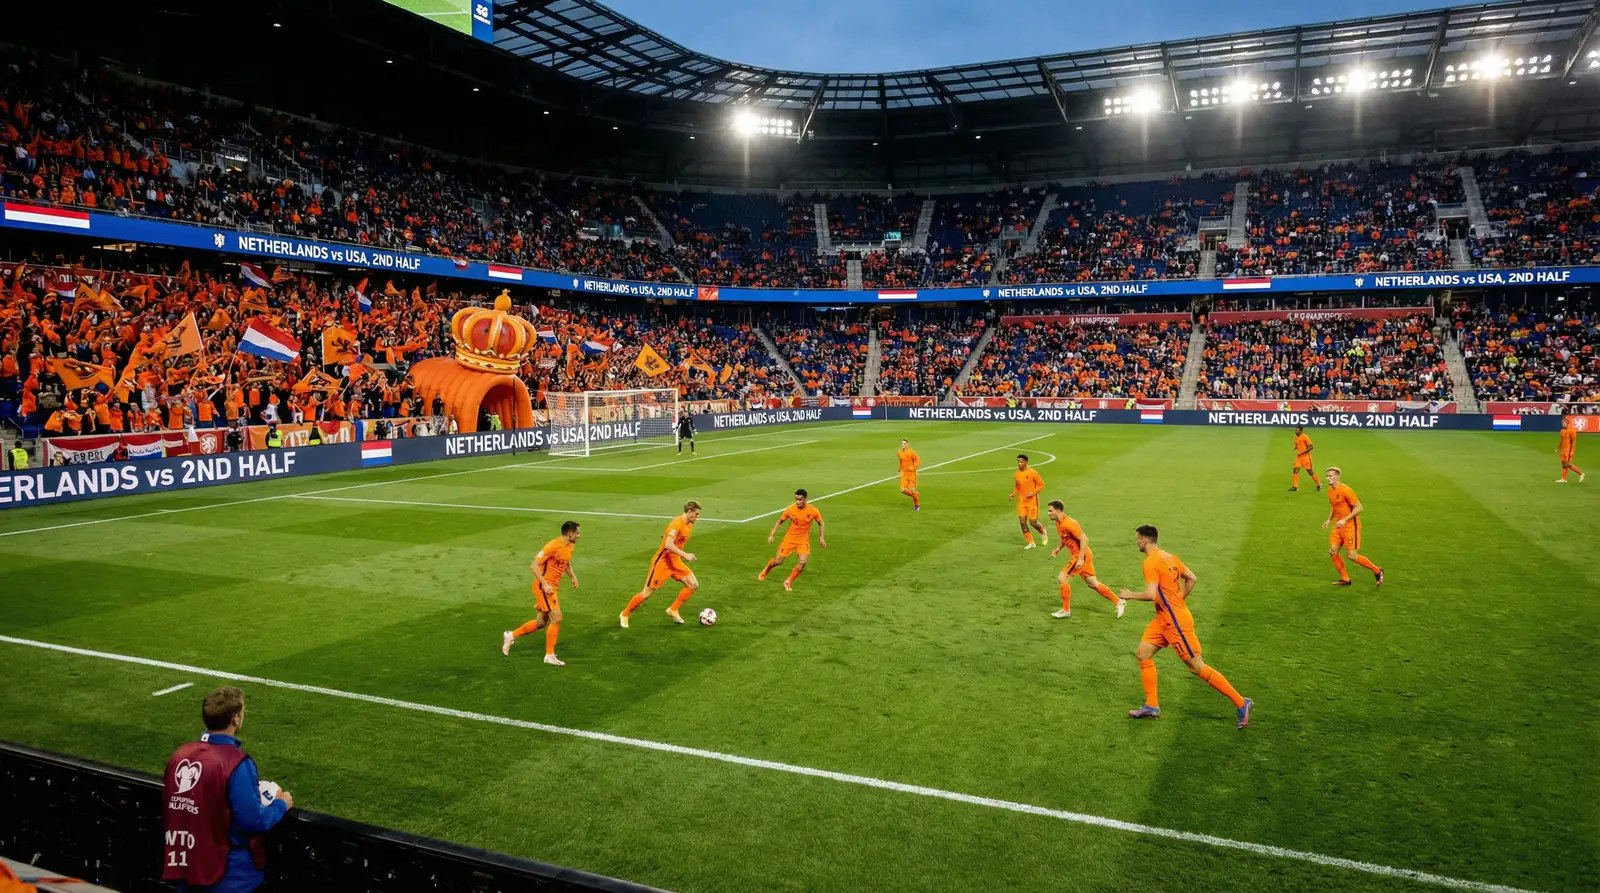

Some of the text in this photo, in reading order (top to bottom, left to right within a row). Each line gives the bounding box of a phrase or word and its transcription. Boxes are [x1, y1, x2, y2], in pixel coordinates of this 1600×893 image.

[238, 236, 421, 270] NETHERLANDS vs USA, 2ND HALF
[1375, 271, 1571, 287] NETHERLANDS vs USA, 2ND HALF
[583, 280, 630, 294] NETHERLANDS
[639, 286, 656, 297] USA,
[657, 287, 673, 296] 2ND
[674, 288, 695, 298] HALF
[998, 284, 1148, 298] NETHERLANDS vs USA, 2ND HALF
[714, 412, 768, 428] NETHERLANDS
[792, 410, 805, 421] 2ND
[806, 409, 822, 420] HALF
[909, 407, 1097, 422] NETHERLANDS vs USA, 2ND HALF
[1208, 412, 1439, 428] NETHERLANDS vs USA, 2ND HALF
[445, 429, 544, 456] NETHERLANDS
[545, 433, 559, 445] vs
[589, 424, 612, 441] 2ND
[614, 421, 641, 438] HALF
[144, 468, 175, 487] vs
[181, 460, 232, 484] 2ND
[239, 451, 296, 479] HALF
[167, 850, 188, 867] 11
